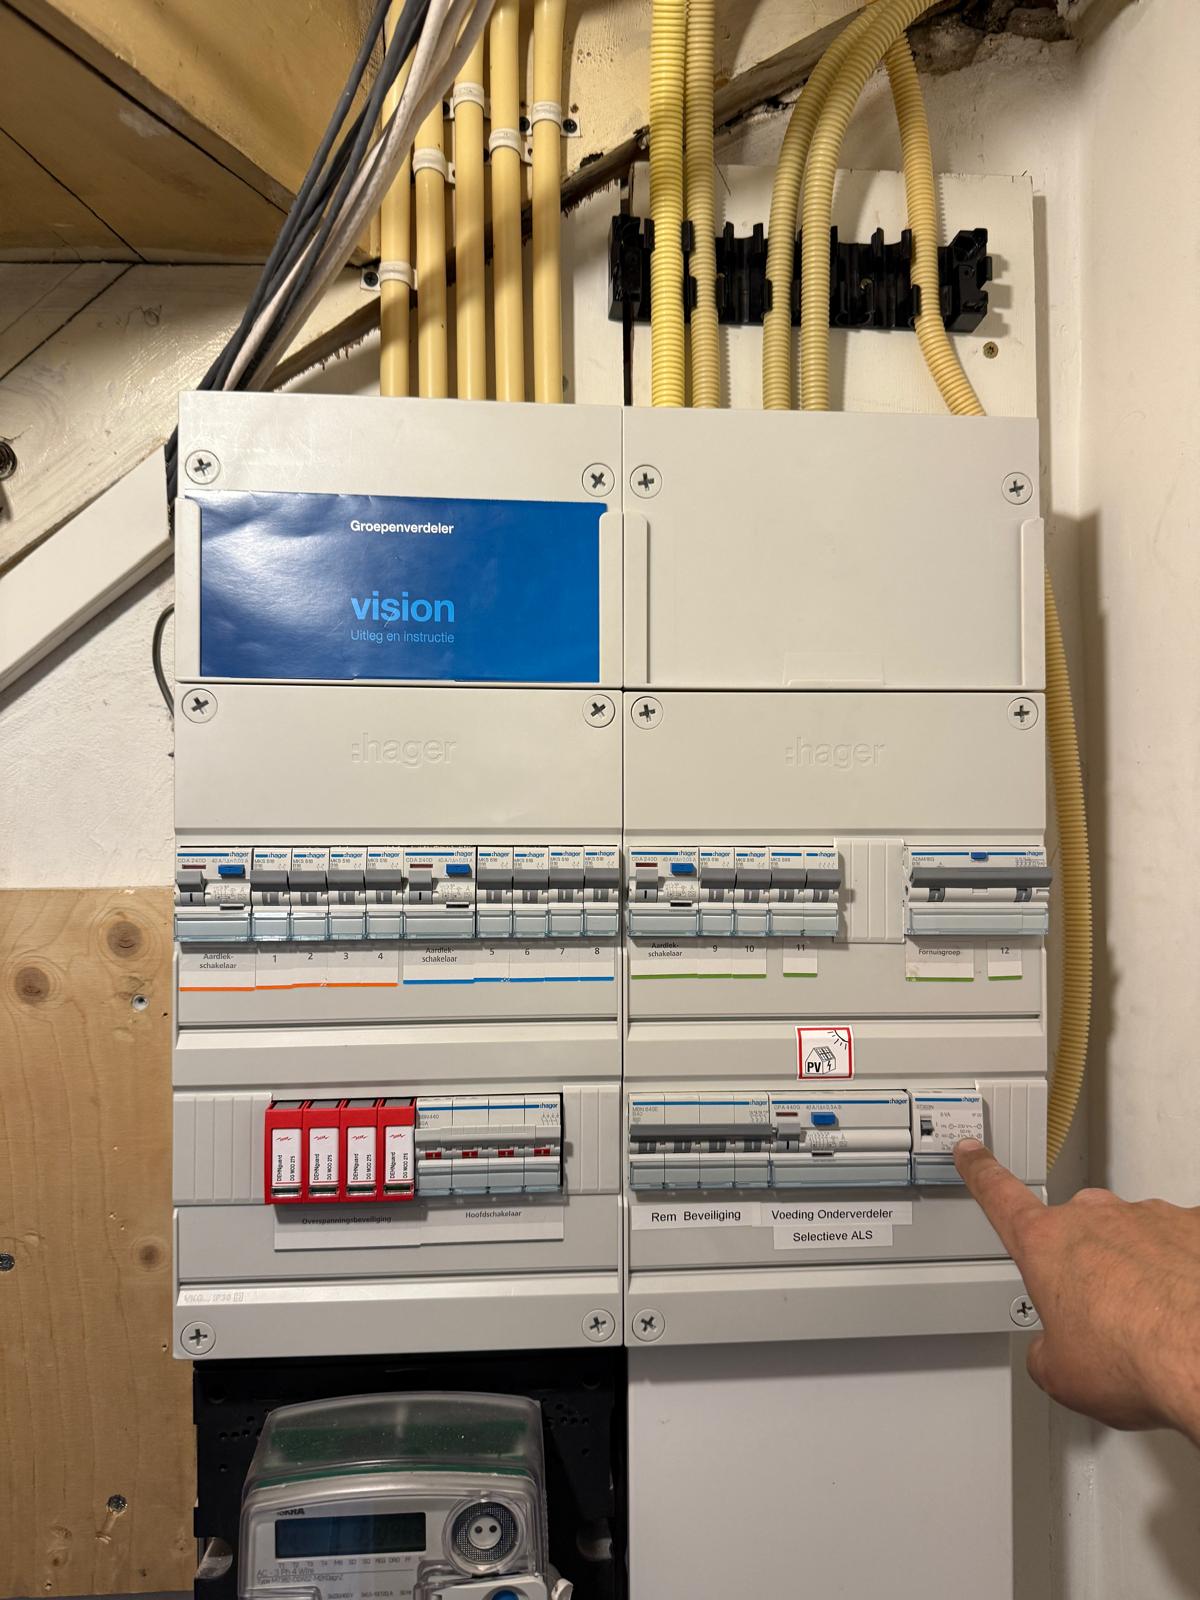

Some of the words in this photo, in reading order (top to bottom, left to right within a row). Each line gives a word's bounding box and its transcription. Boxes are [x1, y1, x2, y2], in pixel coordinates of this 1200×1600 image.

[350, 519, 455, 535] Groepenverdeler
[350, 590, 455, 623] vision
[350, 629, 383, 644] Uitleg
[386, 633, 401, 642] en
[403, 630, 455, 644] instructie
[489, 948, 495, 956] 5
[524, 948, 530, 956] 6
[559, 948, 565, 956] 7
[594, 947, 600, 955] 8
[712, 945, 718, 953] 9
[745, 945, 755, 953] 10
[796, 944, 806, 952] 11
[1000, 947, 1010, 955] 12
[307, 952, 314, 960] 2
[343, 952, 349, 960] 3
[377, 952, 384, 960] 4
[918, 948, 961, 957] Fornuisgroep
[272, 955, 278, 963] 1
[421, 955, 457, 963] schakelaar
[199, 961, 238, 969] schakelaar
[807, 1061, 821, 1073] PV
[465, 1209, 522, 1219] Hoofdschakelaar
[650, 1211, 677, 1223] Rem
[682, 1209, 742, 1223] Beveiliging
[771, 1208, 815, 1221] Voeding
[817, 1208, 893, 1220] Onderverdeler
[792, 1230, 848, 1242] Selectieve
[850, 1229, 873, 1240] ALS
